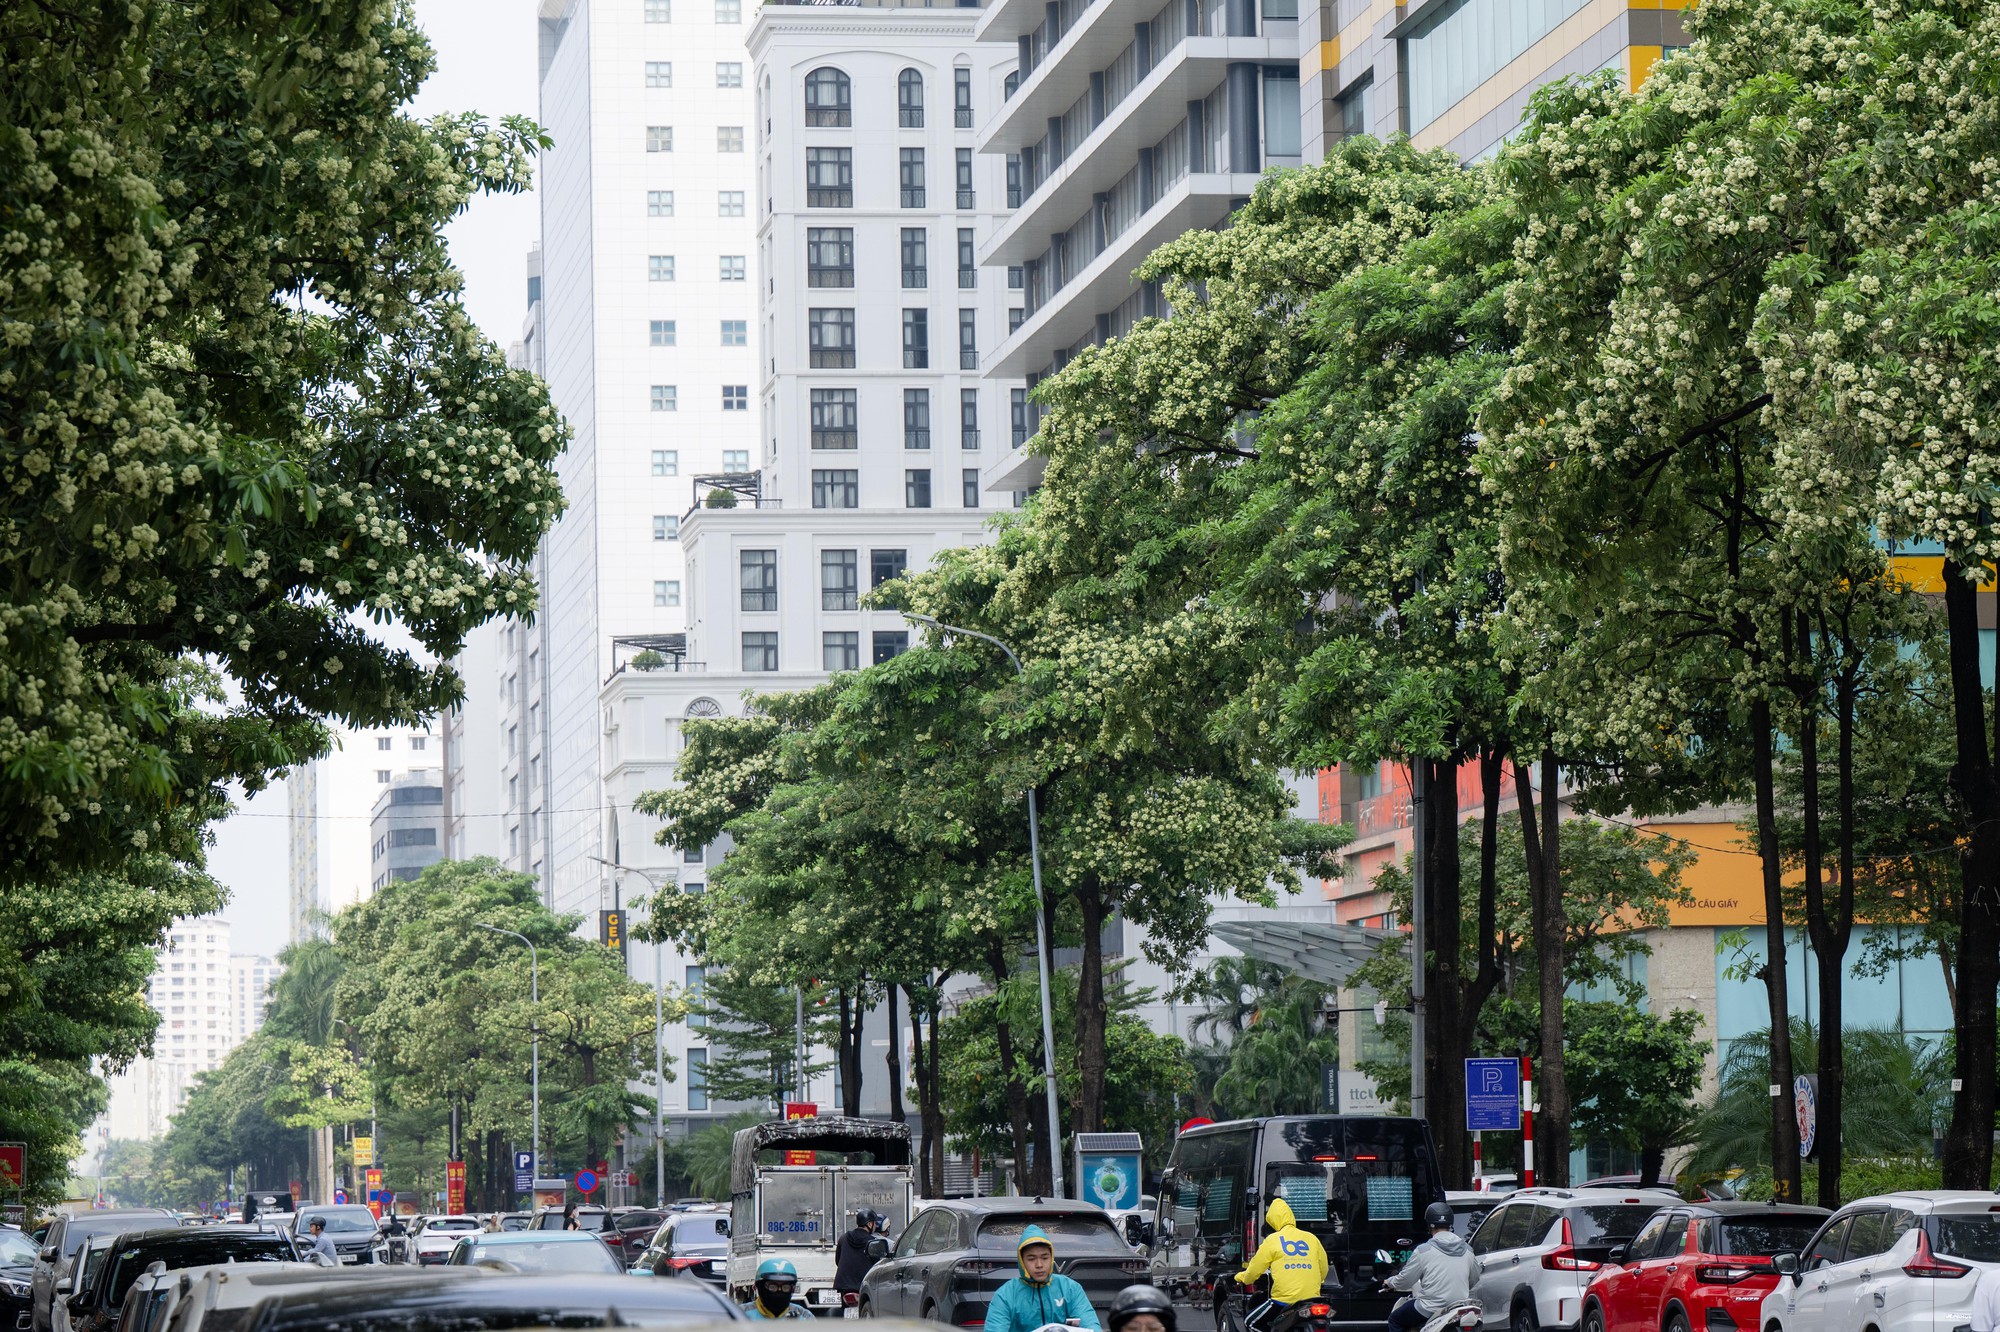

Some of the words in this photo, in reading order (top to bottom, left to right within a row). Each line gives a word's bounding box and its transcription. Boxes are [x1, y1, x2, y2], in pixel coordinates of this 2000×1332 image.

[607, 913, 620, 949] GEM
[1482, 1067, 1503, 1092] P
[519, 1154, 530, 1168] P
[767, 1221, 818, 1232] 88C-286.91
[1279, 1235, 1310, 1256] be
